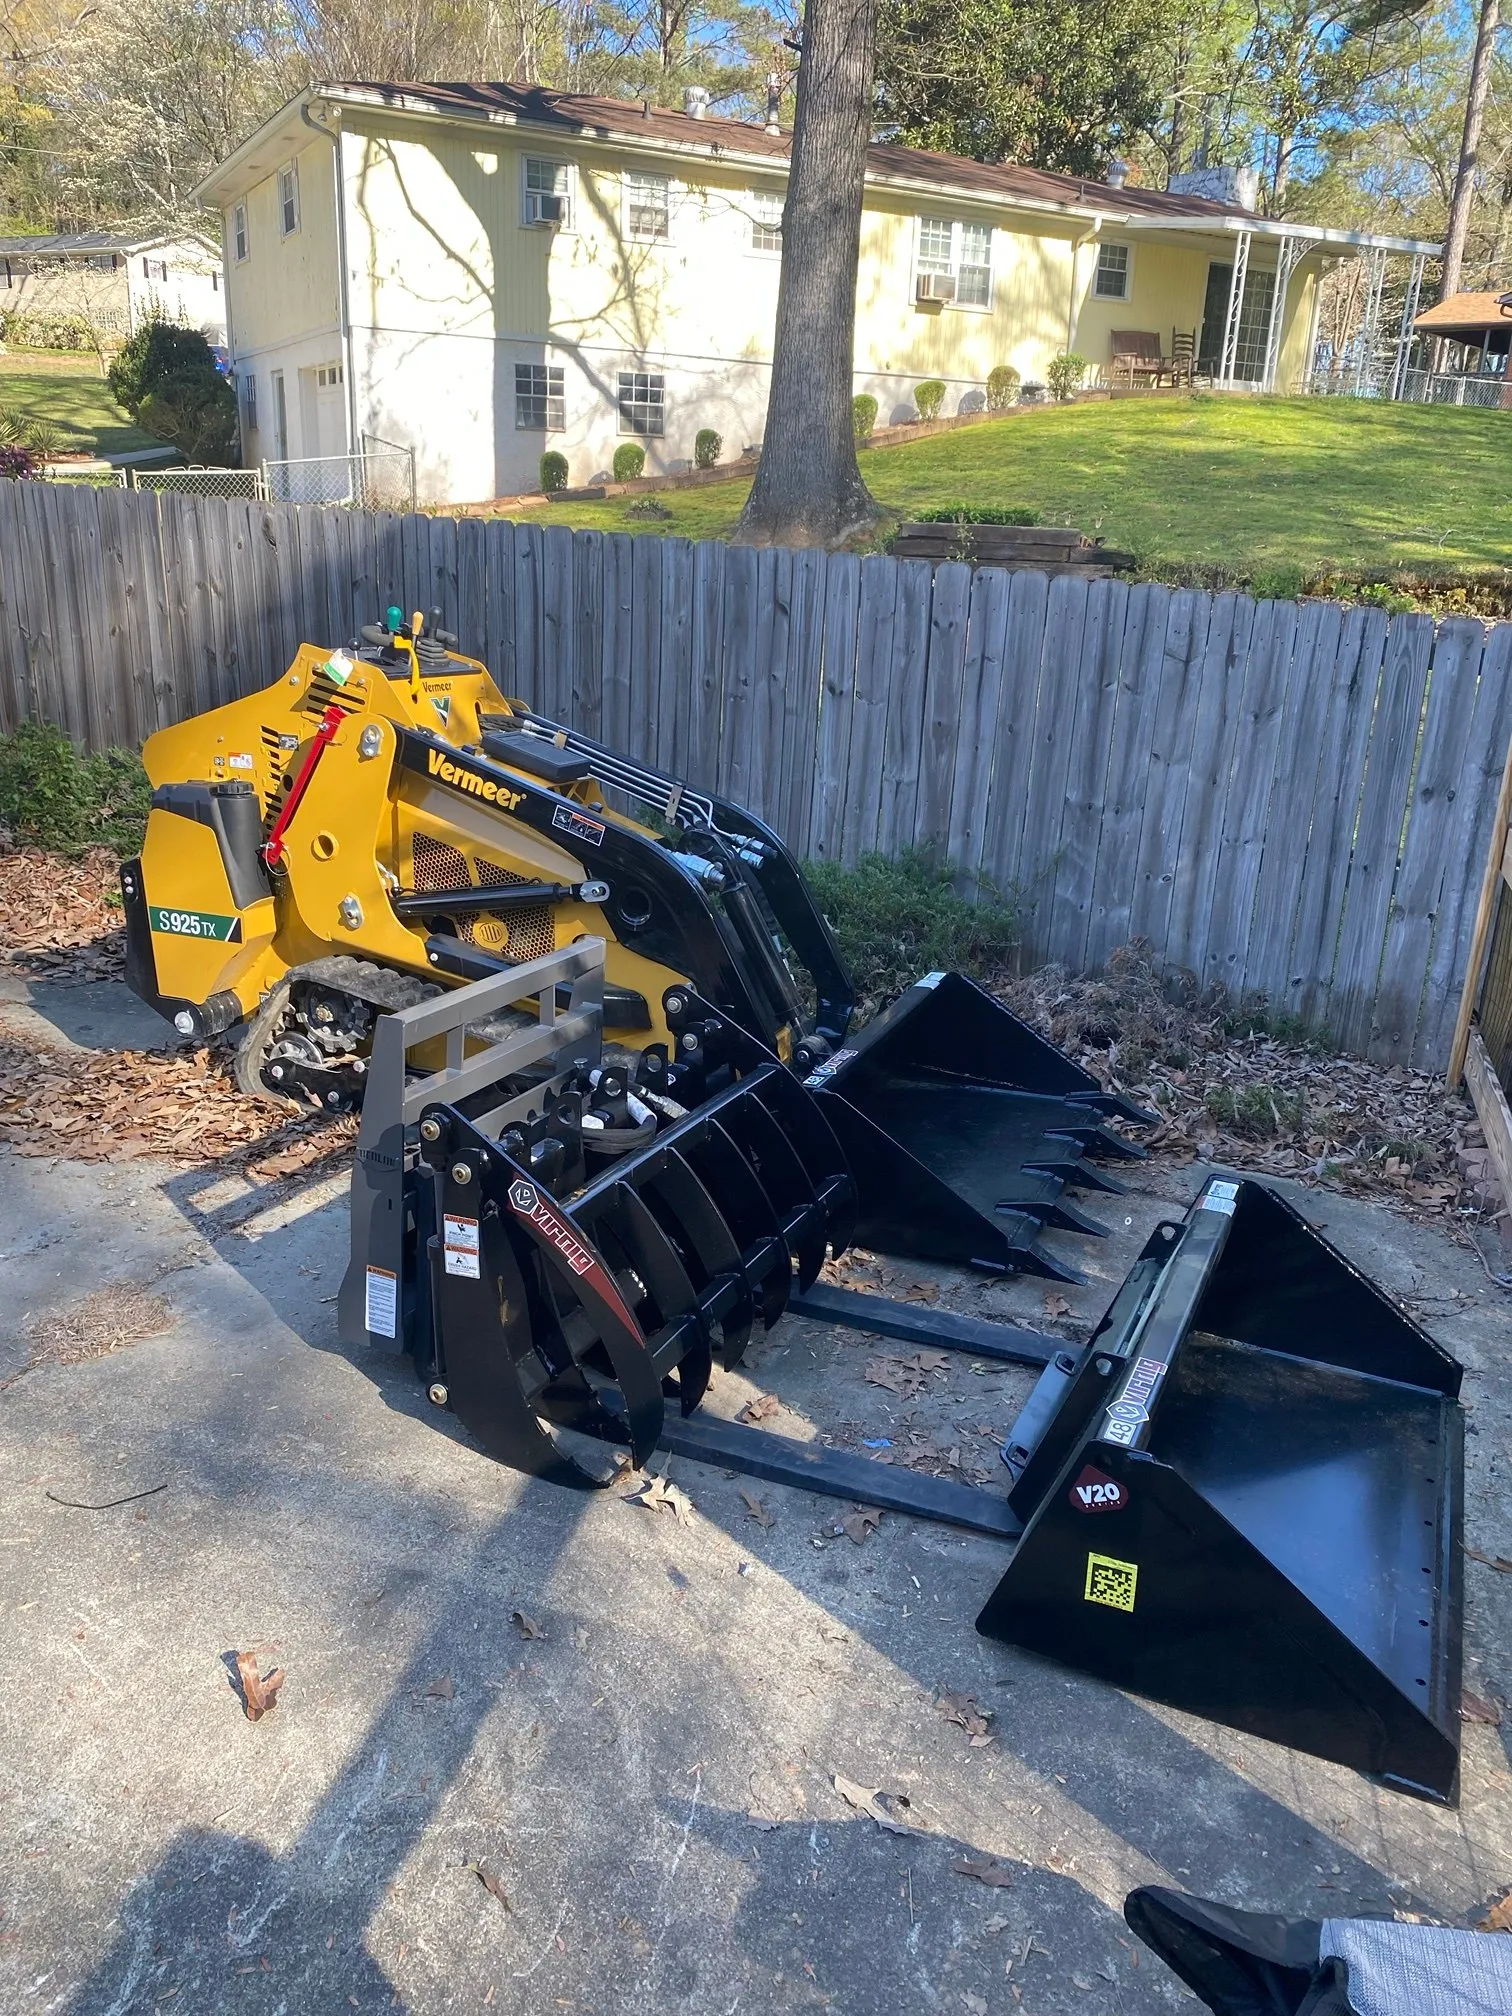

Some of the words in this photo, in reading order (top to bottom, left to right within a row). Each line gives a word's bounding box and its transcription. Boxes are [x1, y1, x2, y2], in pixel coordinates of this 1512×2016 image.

[422, 681, 452, 692] Vermeer
[428, 748, 522, 811] Vermeer
[1109, 1422, 1132, 1440] 48
[1076, 1482, 1121, 1504] V20
